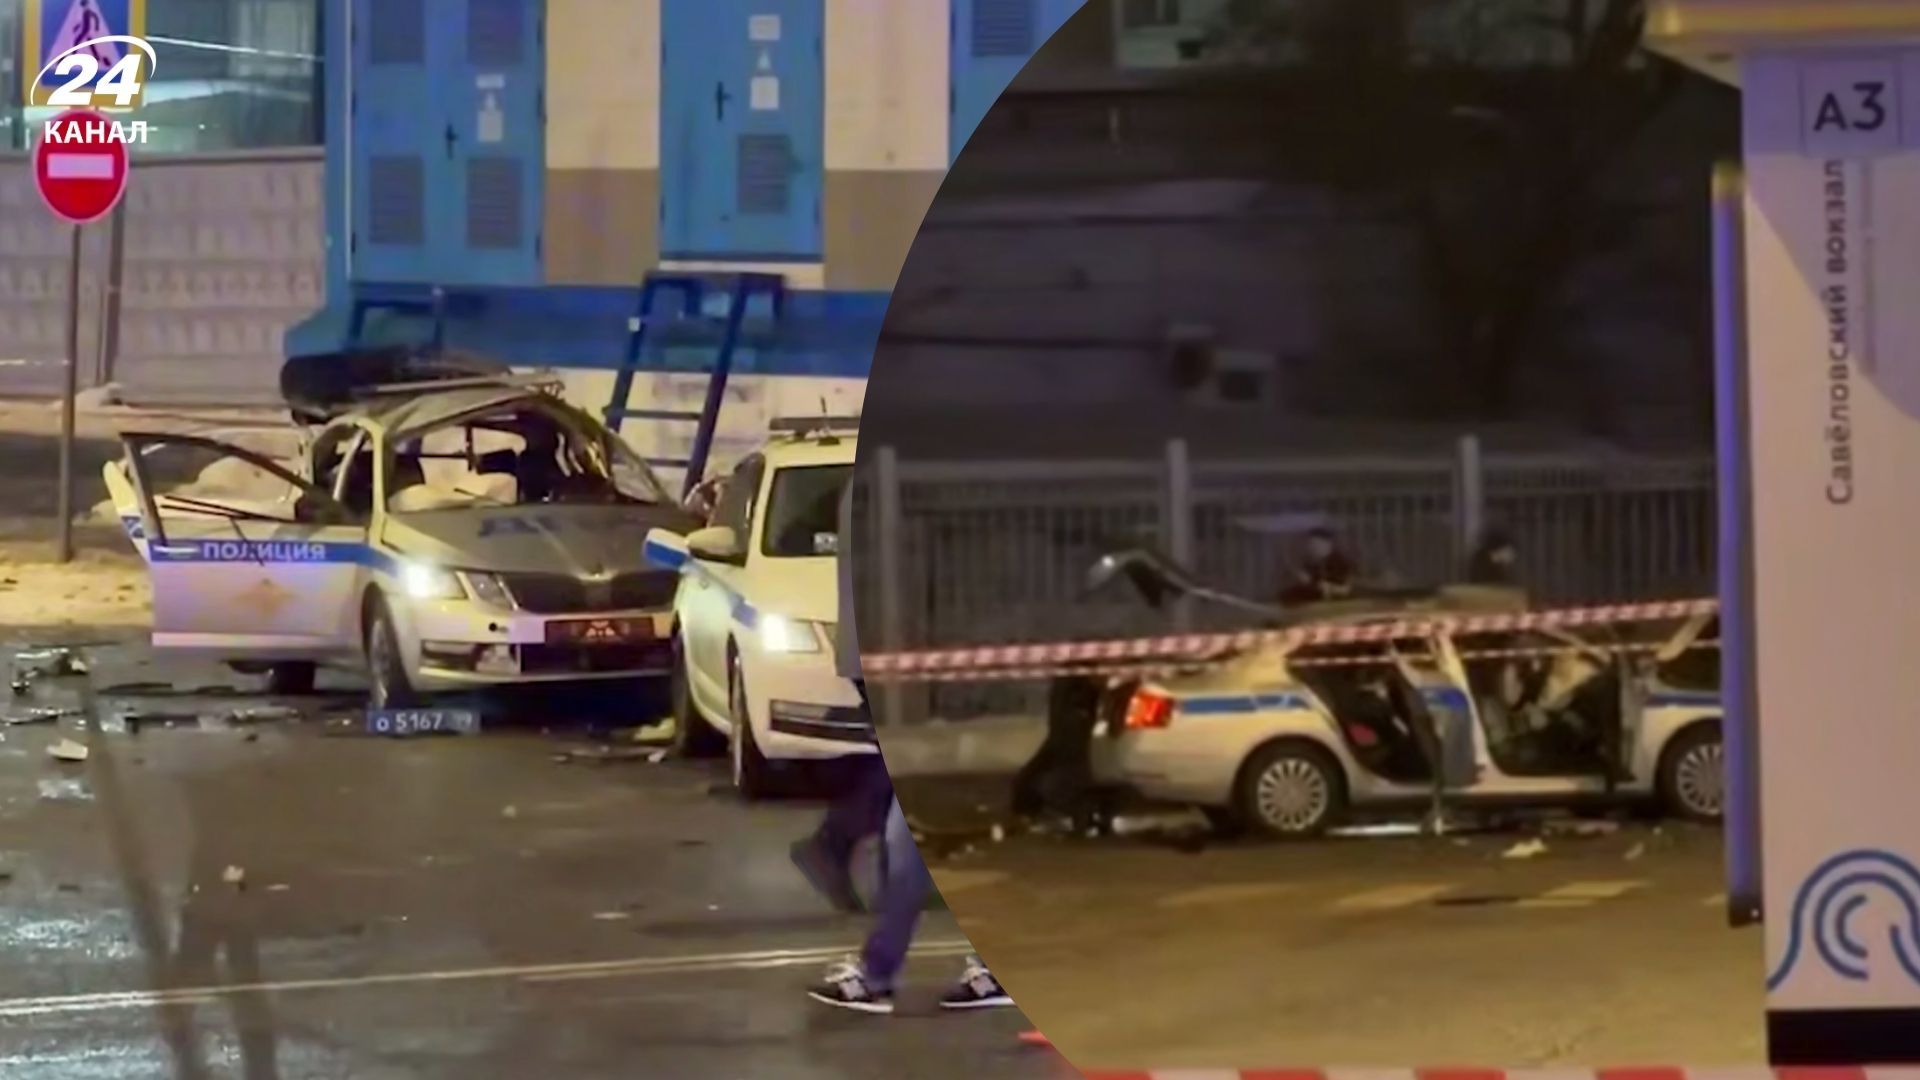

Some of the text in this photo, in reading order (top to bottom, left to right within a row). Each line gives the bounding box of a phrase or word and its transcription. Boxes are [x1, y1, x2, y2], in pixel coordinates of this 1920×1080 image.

[1813, 81, 1886, 132] А3
[1822, 160, 1853, 504] Савёловский вокзал
[203, 542, 325, 562] ПОЛИЦИЯ
[395, 711, 443, 731] 5167
